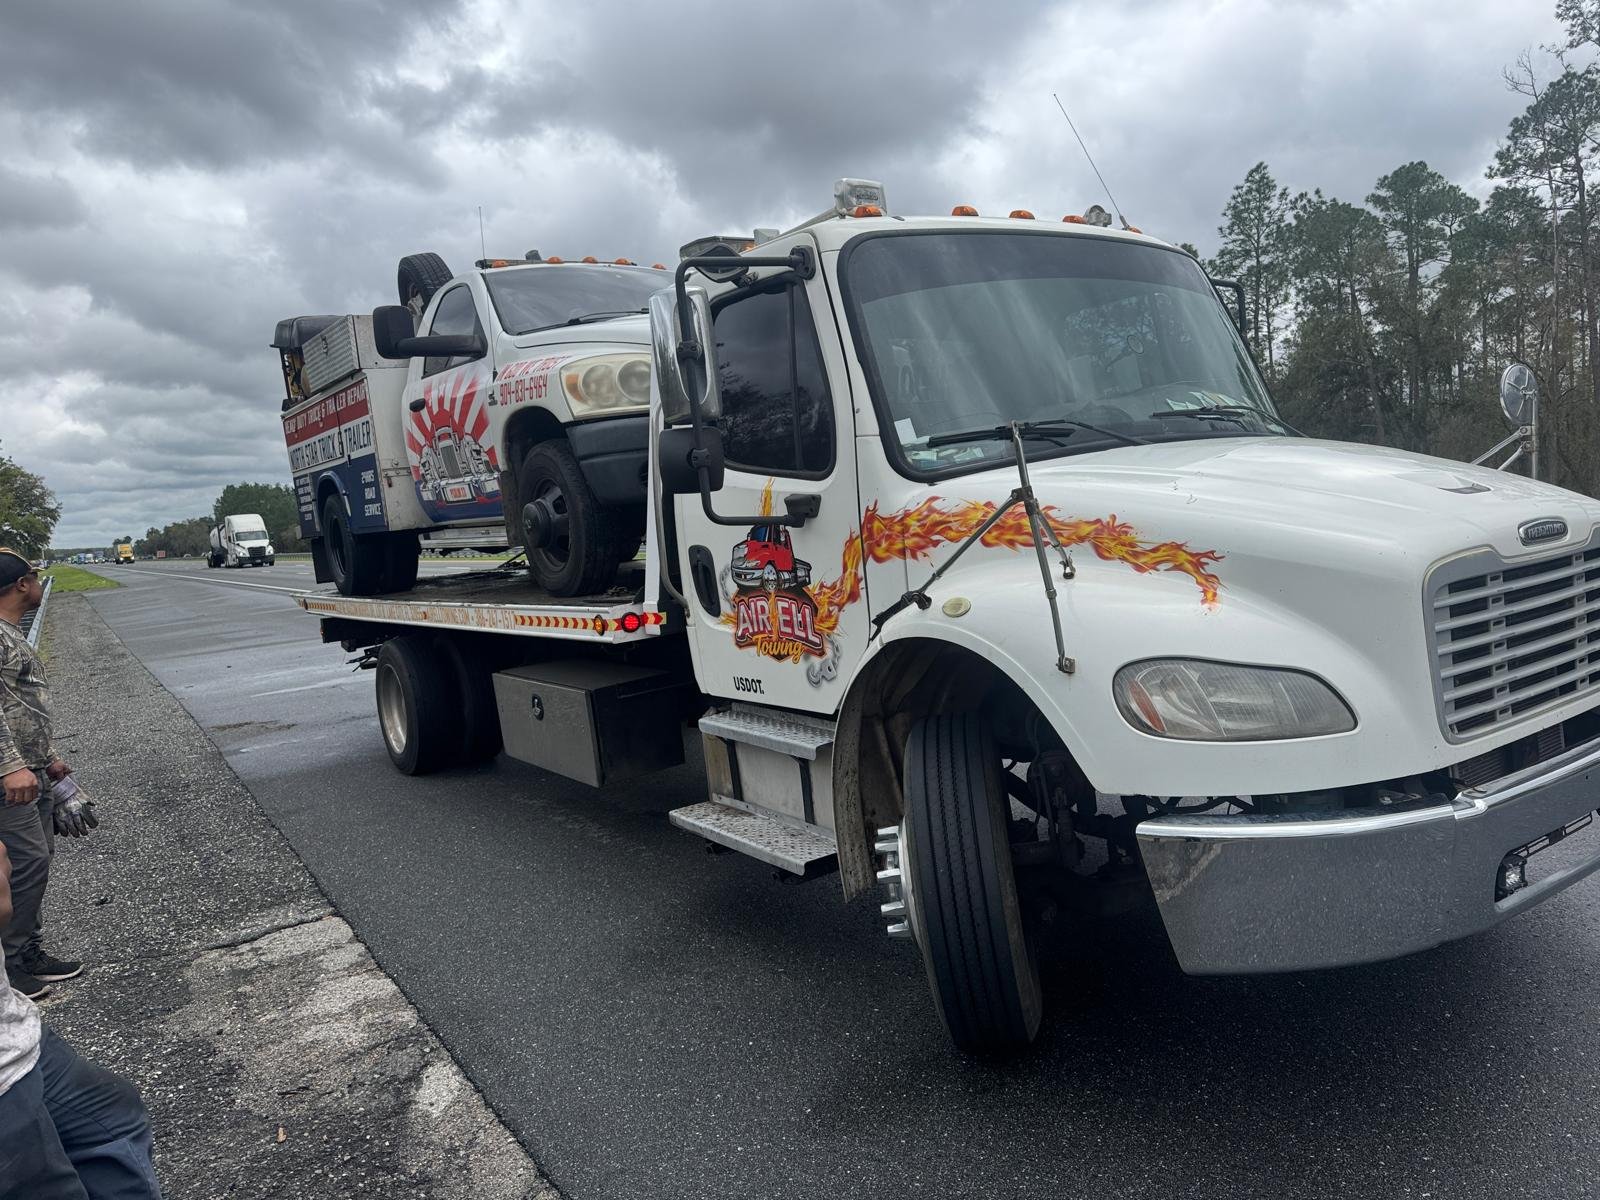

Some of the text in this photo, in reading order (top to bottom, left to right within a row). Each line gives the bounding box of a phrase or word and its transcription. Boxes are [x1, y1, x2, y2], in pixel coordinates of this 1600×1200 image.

[500, 374, 548, 406] 904-831-6464
[305, 441, 319, 466] STAR
[318, 433, 337, 461] TRUCK
[344, 420, 371, 453] TRAILER
[364, 503, 382, 516] SERVICE
[737, 598, 821, 645] AIR ELL
[752, 634, 804, 664] Towing
